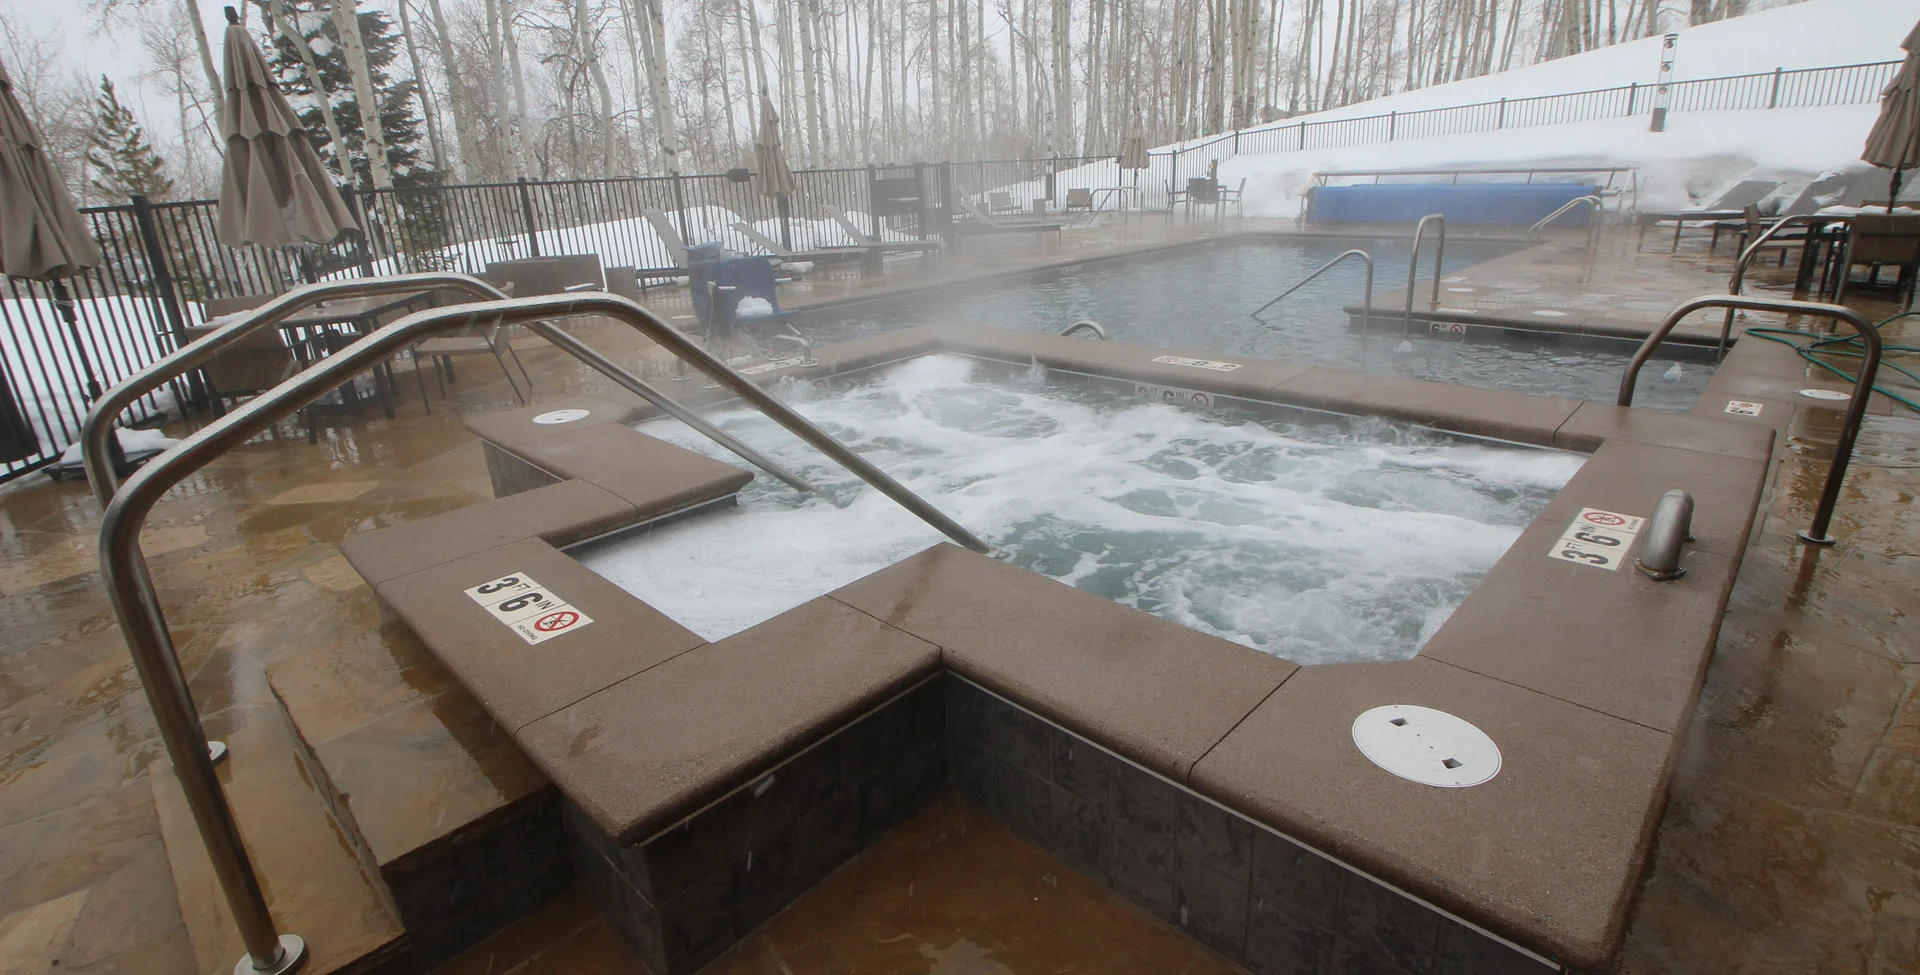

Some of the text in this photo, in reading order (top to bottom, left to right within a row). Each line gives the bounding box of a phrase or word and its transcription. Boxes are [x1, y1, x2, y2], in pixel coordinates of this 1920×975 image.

[1565, 542, 1583, 550] FT
[1574, 531, 1621, 547] 6
[1561, 549, 1609, 565] 3
[477, 577, 556, 612] 3 FT 6 IN
